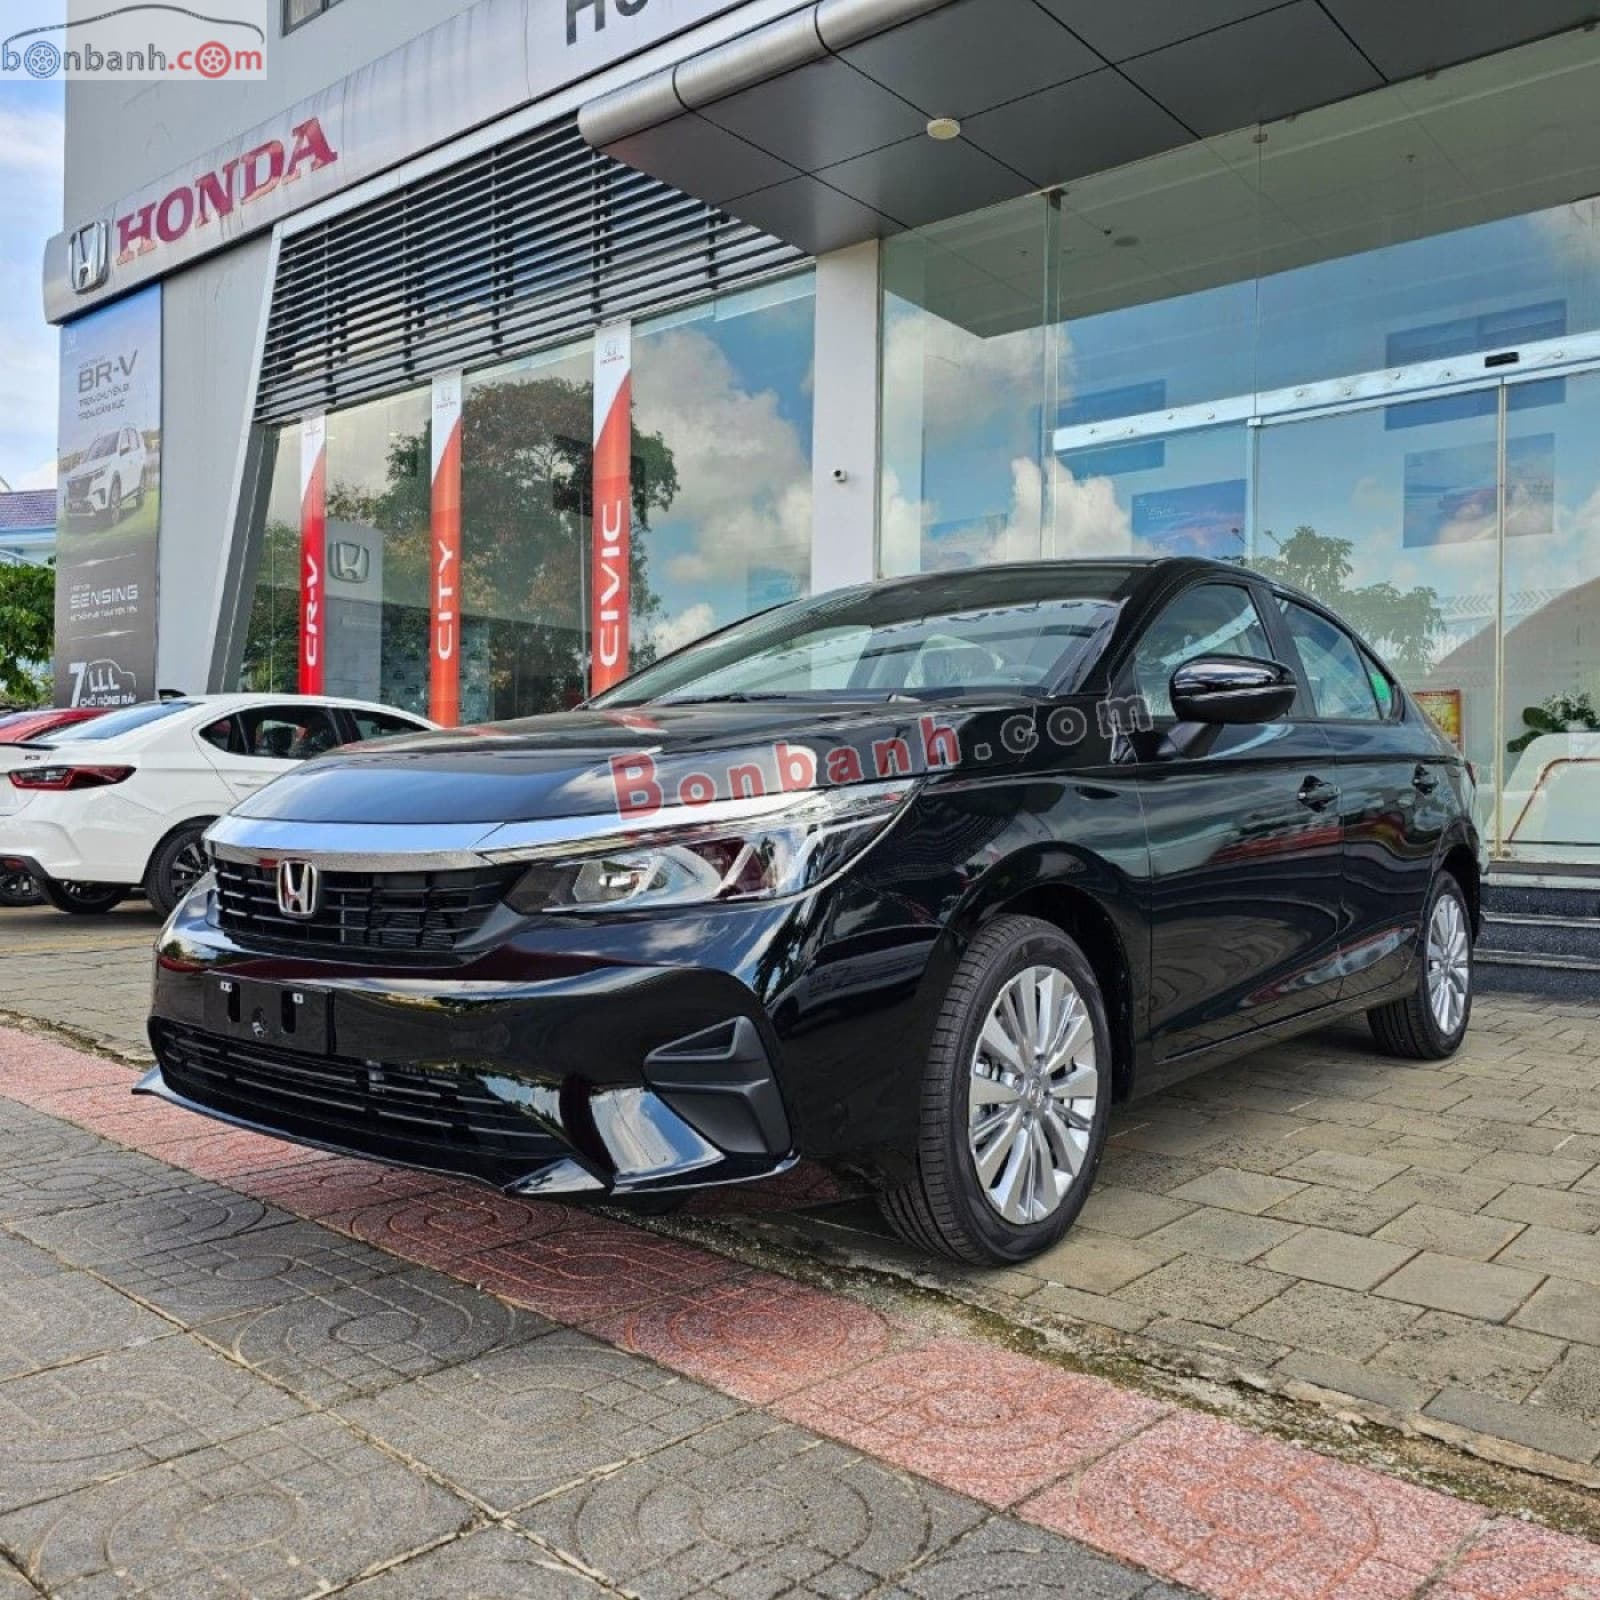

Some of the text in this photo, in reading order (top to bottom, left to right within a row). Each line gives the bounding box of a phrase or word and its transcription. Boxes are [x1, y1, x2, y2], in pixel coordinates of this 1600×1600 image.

[116, 117, 338, 265] HONDA
[79, 350, 138, 394] BR-V
[70, 584, 138, 609] SENSING
[306, 553, 318, 666] CR-V
[438, 540, 453, 660] CITY
[600, 500, 622, 667] CIVIC
[69, 662, 87, 708] 7
